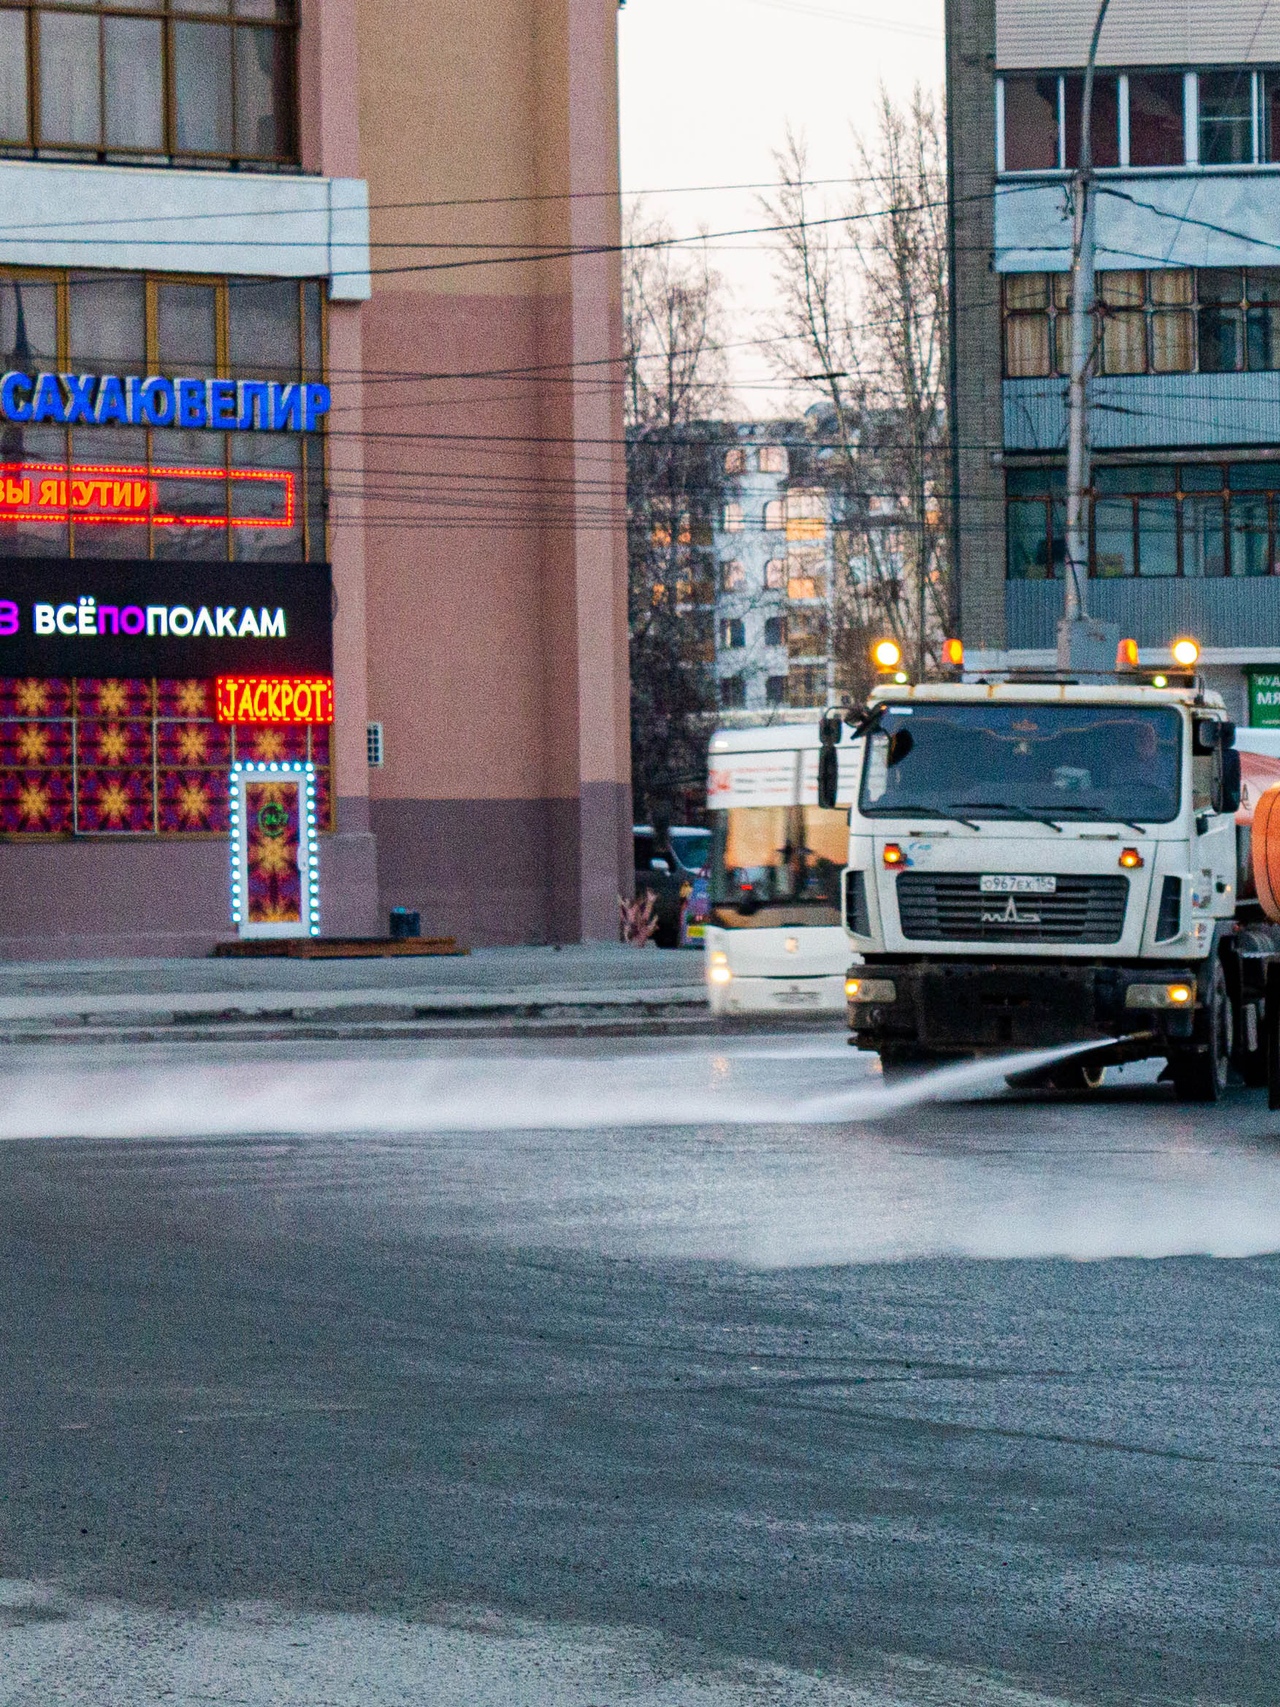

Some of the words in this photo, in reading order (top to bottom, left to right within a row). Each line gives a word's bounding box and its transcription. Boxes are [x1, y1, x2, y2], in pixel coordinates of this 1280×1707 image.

[1, 372, 331, 431] САХАЮВЕЛИР
[39, 479, 148, 507] ЯКУТИИ
[223, 683, 327, 717] JACKPOT
